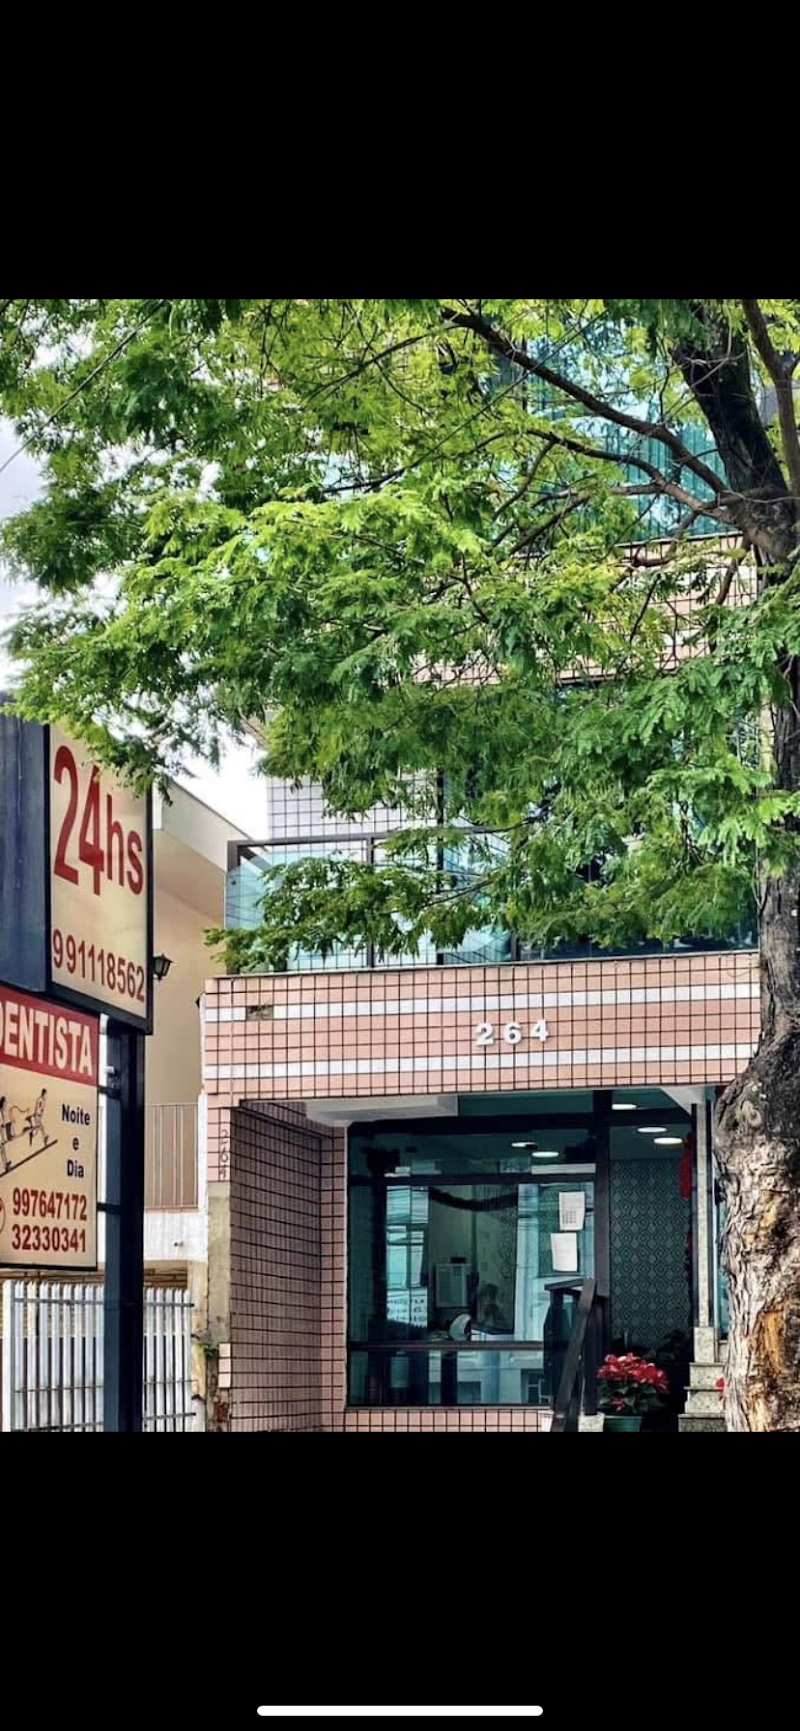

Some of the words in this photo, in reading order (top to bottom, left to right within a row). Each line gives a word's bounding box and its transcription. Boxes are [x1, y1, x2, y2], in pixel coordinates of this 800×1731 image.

[54, 745, 143, 895] 24hs
[53, 929, 144, 1000] 991118562
[0, 1000, 93, 1076] ENTISTA
[475, 1019, 548, 1046] 264
[62, 1103, 90, 1125] Noite
[73, 1137, 79, 1150] e
[67, 1160, 84, 1178] Dia
[13, 1187, 87, 1221] 997647172
[12, 1224, 86, 1252] 32330341
